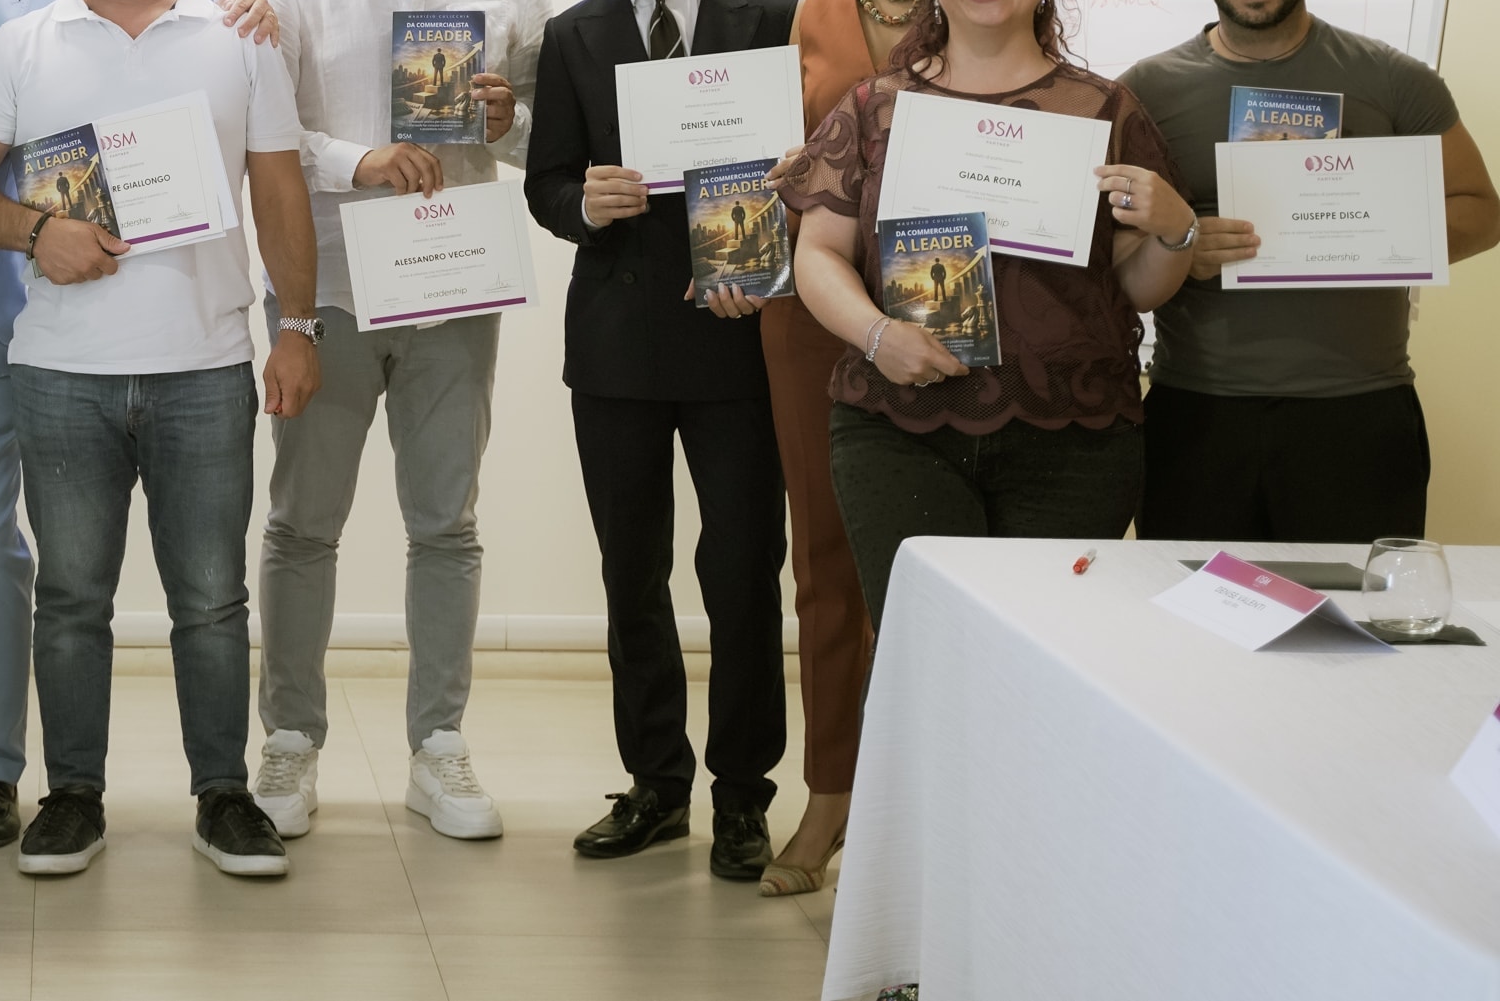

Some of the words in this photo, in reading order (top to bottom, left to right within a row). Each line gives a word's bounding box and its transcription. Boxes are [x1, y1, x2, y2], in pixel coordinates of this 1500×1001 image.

[404, 30, 414, 42] A
[418, 30, 472, 42] LEADER
[688, 67, 730, 86] OSM
[1258, 101, 1322, 112] COMMERCIALISTA
[681, 120, 709, 131] DENISE
[711, 117, 743, 127] VALENTI
[1244, 109, 1256, 122] A
[1260, 111, 1325, 129] LEADER
[977, 118, 1023, 140] OSM
[32, 138, 82, 158] COMMERCIALISTA
[100, 131, 138, 151] OSM
[24, 163, 35, 175] A
[36, 146, 88, 172] LEADER
[693, 155, 738, 167] Leadership
[1304, 154, 1354, 173] OSM
[123, 174, 171, 191] GIALLONGO
[710, 170, 766, 183] COMMERCIALISTA
[958, 170, 990, 183] GIADA
[993, 175, 1022, 188] ROTTA
[699, 187, 710, 199] A
[713, 179, 771, 197] LEADER
[414, 202, 455, 221] OSM
[1291, 212, 1337, 221] GIUSEPPE
[1339, 211, 1370, 220] DISCA
[895, 230, 906, 238] DA
[907, 226, 969, 236] COMMERCIALISTA
[894, 240, 907, 254] A
[911, 234, 974, 252] LEADER
[394, 253, 447, 267] ALESSANDRO
[448, 247, 486, 259] VECCHIO
[1305, 252, 1360, 263] Leadership
[423, 286, 468, 300] Leadership
